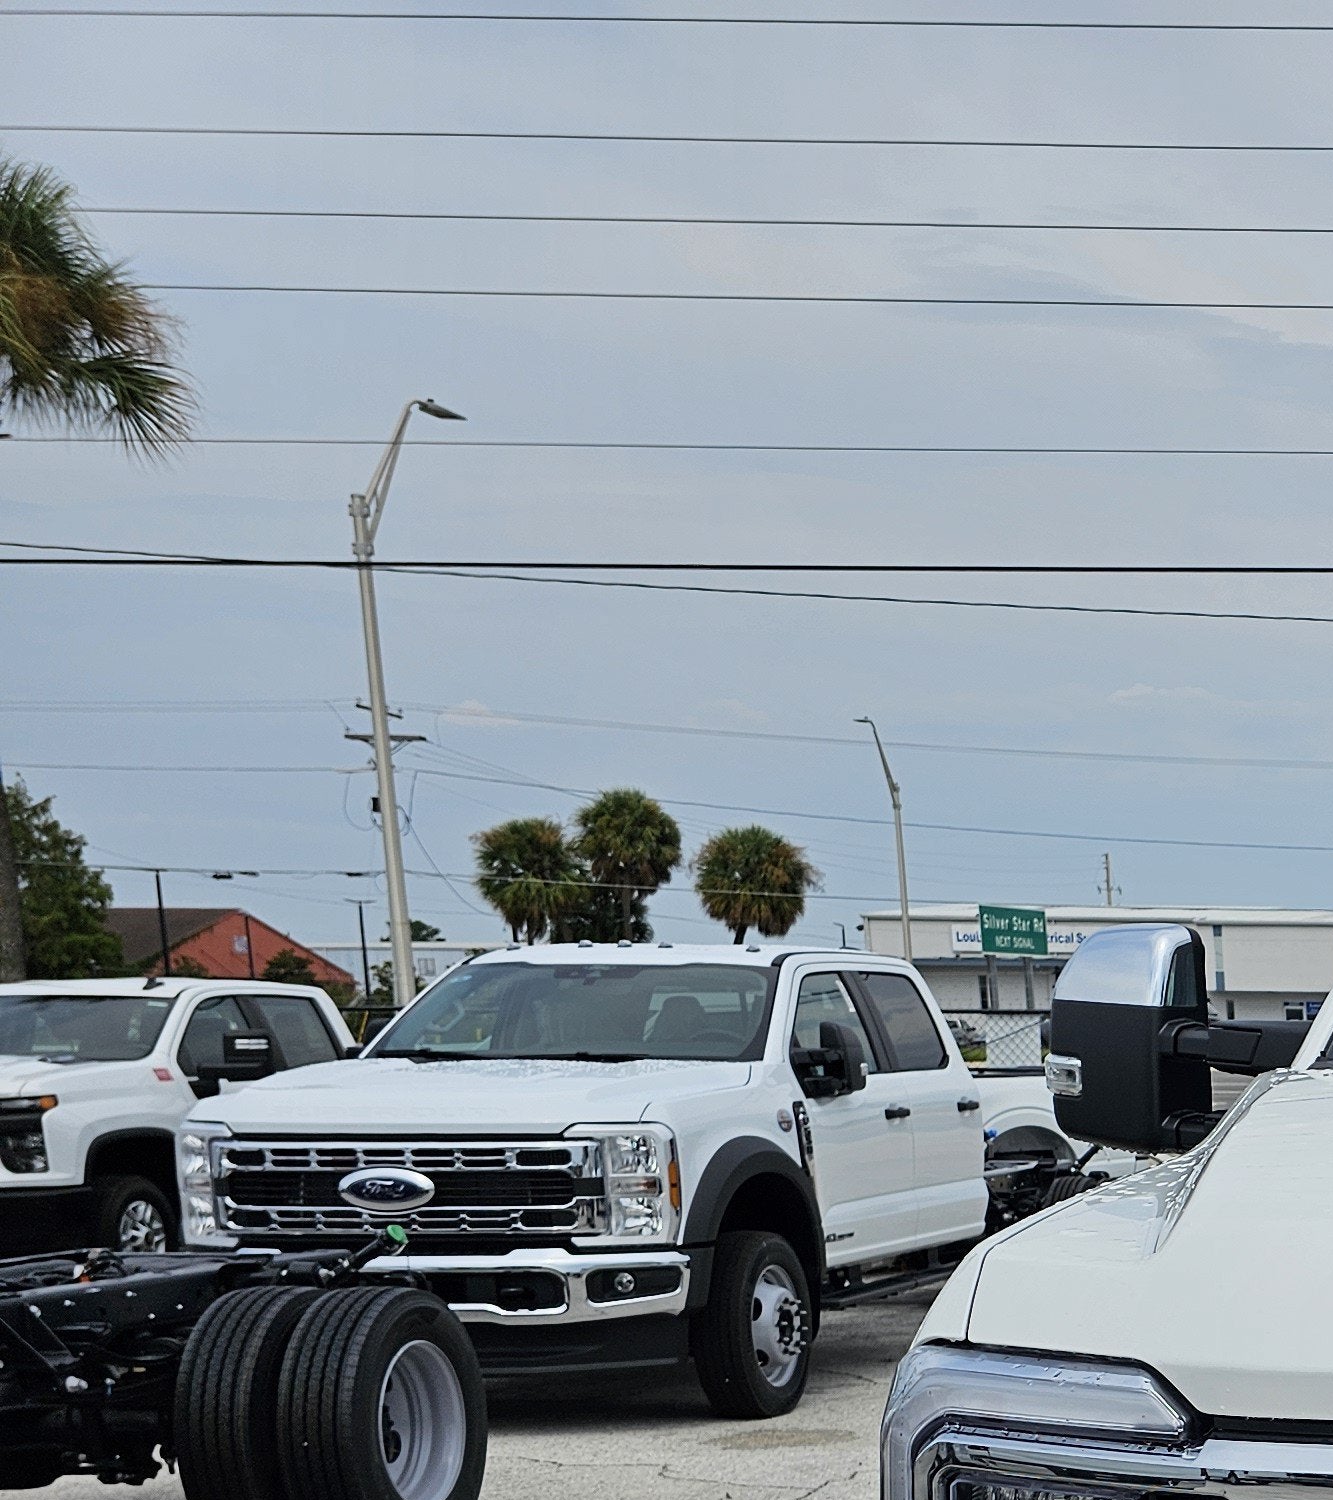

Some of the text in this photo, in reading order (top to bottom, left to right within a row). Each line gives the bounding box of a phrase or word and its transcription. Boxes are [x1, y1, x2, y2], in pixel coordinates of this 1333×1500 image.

[982, 913, 1044, 933] Silver Star Rd
[995, 935, 1035, 949] NEXT SIGNAL
